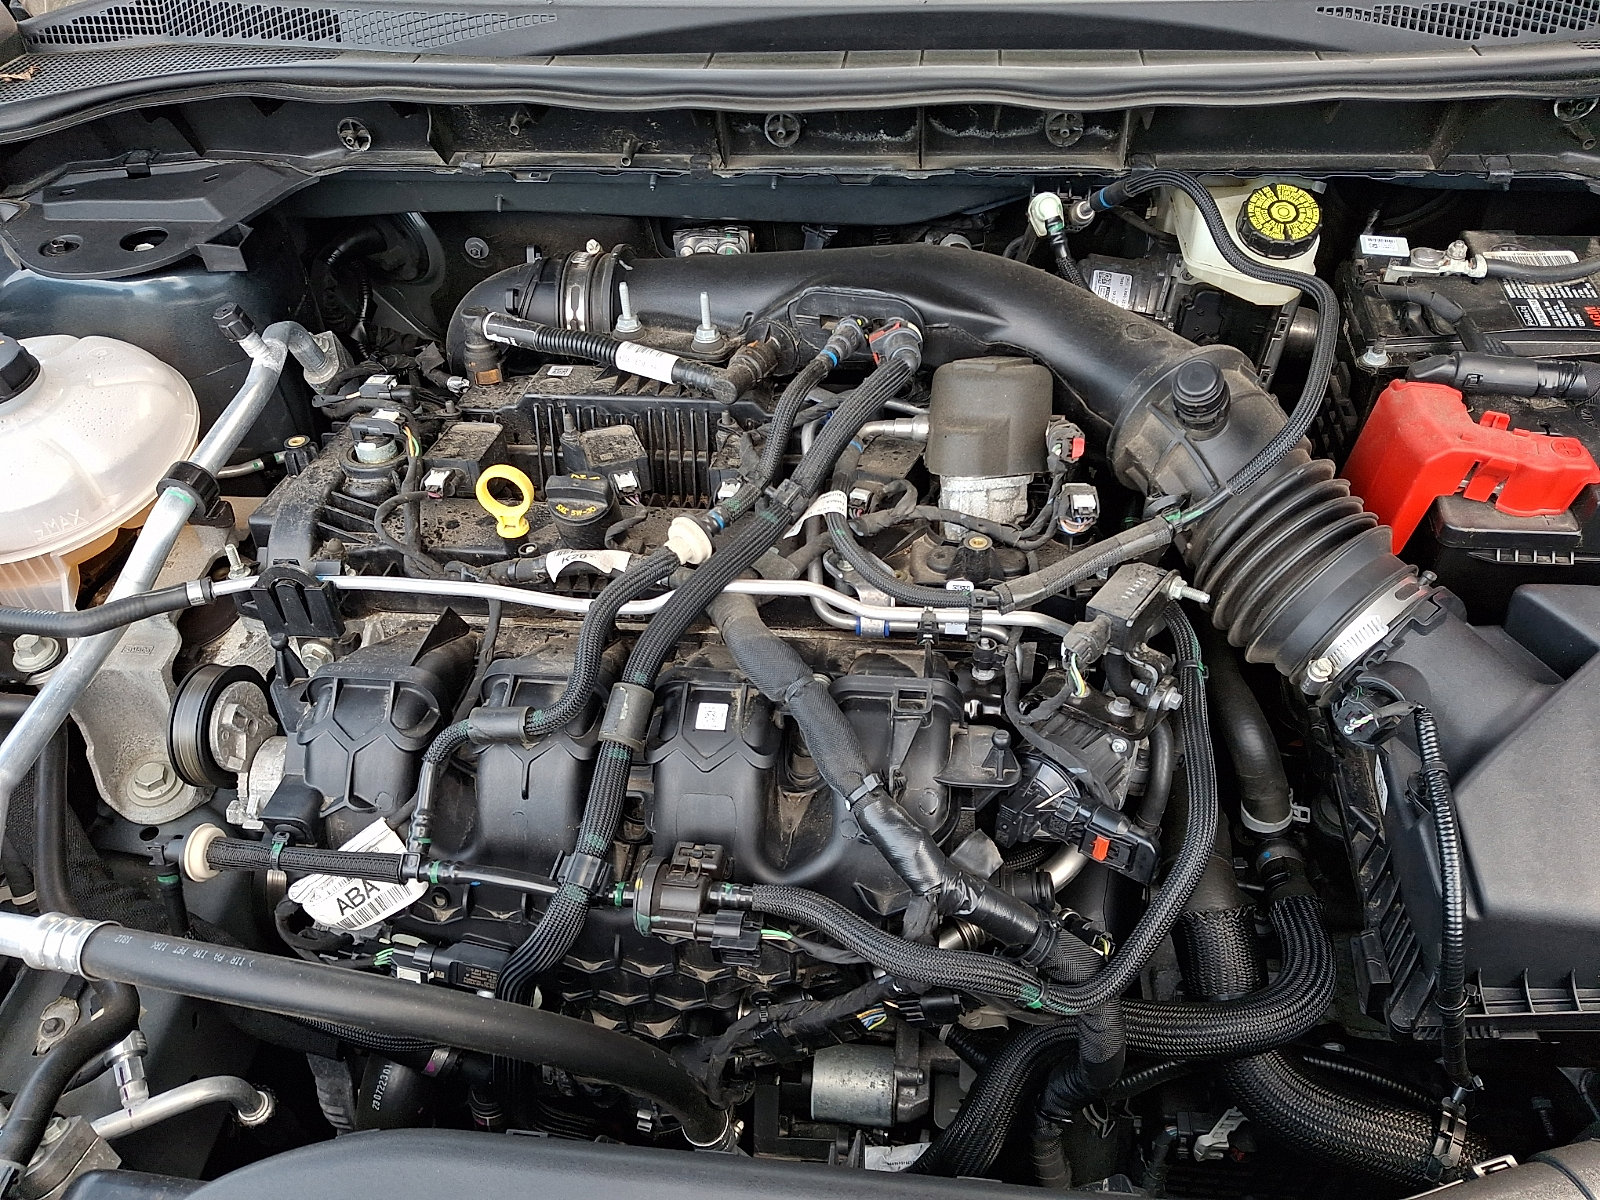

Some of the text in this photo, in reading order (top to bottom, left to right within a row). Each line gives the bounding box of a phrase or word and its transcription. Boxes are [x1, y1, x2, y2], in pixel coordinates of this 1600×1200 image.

[43, 508, 90, 534] MAX
[336, 879, 381, 916] ABA
[372, 1064, 393, 1111] 230722301
